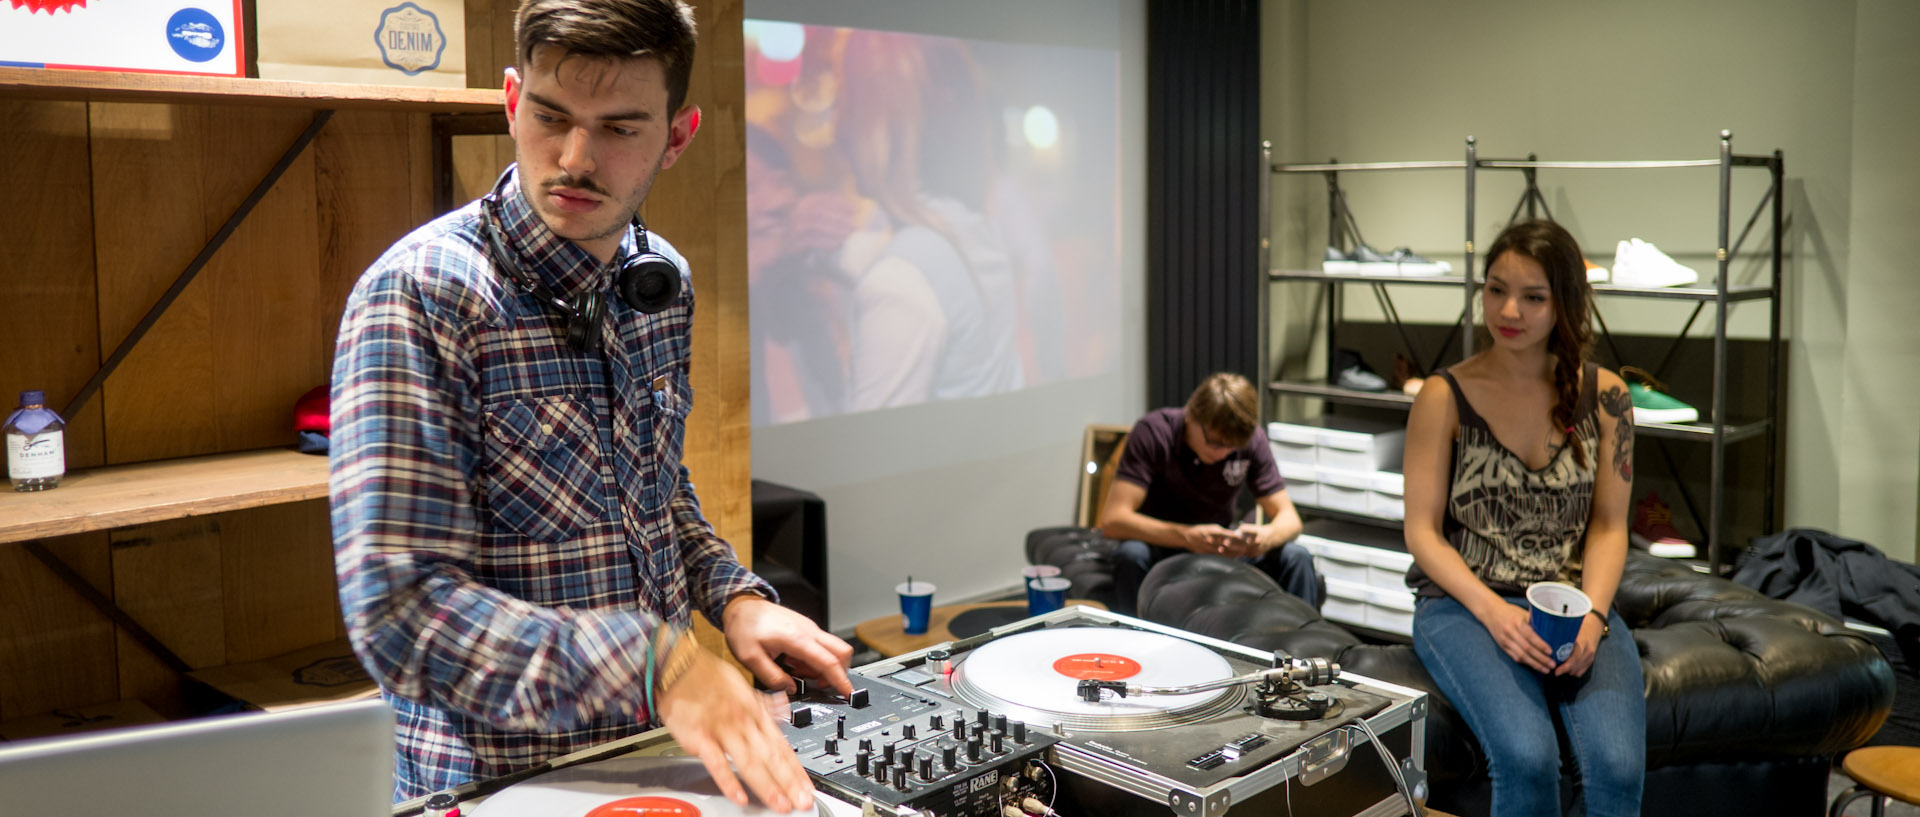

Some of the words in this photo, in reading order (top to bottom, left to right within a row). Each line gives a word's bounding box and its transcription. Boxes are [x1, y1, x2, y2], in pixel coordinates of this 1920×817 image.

[388, 31, 433, 52] DENIM
[19, 450, 55, 458] DENHAM
[970, 771, 997, 793] RANE
